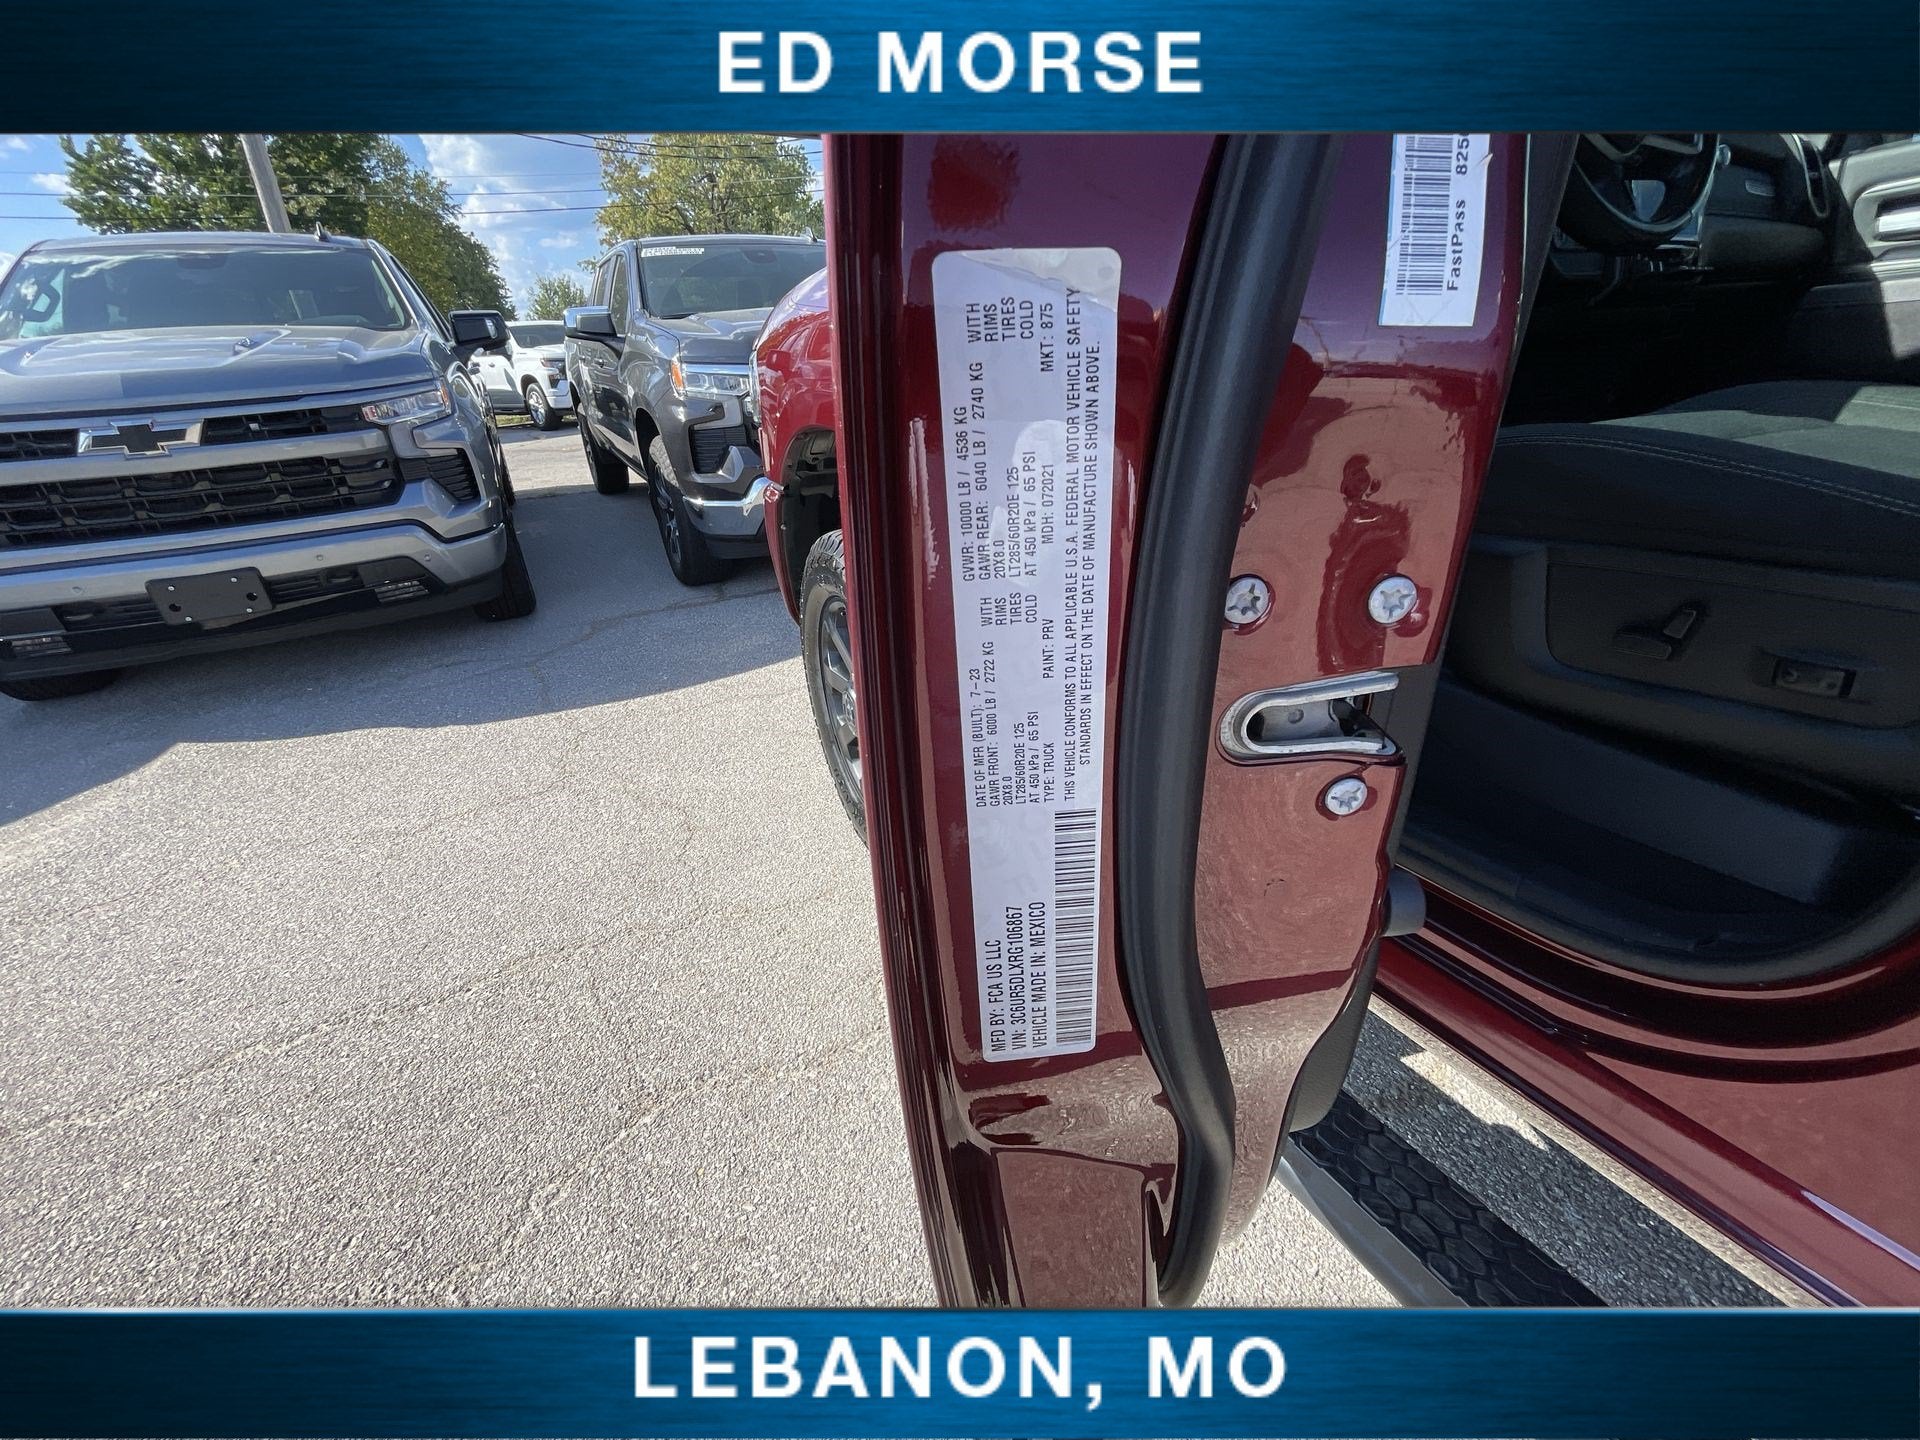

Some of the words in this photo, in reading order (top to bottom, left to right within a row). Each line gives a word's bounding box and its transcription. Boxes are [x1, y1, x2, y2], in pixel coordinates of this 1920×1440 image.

[1447, 200, 1465, 290] FastPass
[966, 303, 981, 343] WITH
[983, 304, 998, 341] RIMS
[1001, 297, 1015, 341] TIRES
[1020, 301, 1034, 339] COLD
[1040, 303, 1053, 329] 875
[1066, 288, 1080, 345] SAFETY
[1040, 336, 1054, 372] MKT:
[1086, 341, 1099, 393] ABOVE.
[970, 363, 983, 380] KG
[1067, 351, 1080, 411] VEHICLE
[954, 407, 967, 424] KG
[971, 388, 984, 419] 2740
[1085, 399, 1099, 450] SHOWN
[955, 431, 969, 461] 4536
[973, 441, 986, 456] LB
[1066, 416, 1080, 463] MOTOR
[1022, 451, 1035, 471] PSI
[958, 481, 970, 496] LB
[974, 462, 987, 491] 6040
[1007, 467, 1019, 488] 125
[1023, 478, 1035, 492] 65
[1041, 464, 1053, 507] 072021
[1066, 468, 1079, 525] FEDERAL
[1083, 456, 1097, 550] MANUFACTURE
[959, 502, 973, 536] 10000
[975, 501, 989, 539] REAR:
[1024, 511, 1036, 532] kPa
[1042, 513, 1054, 544] MDH:
[1007, 494, 1021, 577] LT285/60R20E
[1024, 537, 1036, 556] 450
[1066, 531, 1078, 567] U.S.A.
[962, 541, 974, 581] GVWR:
[977, 544, 991, 580] GAWR
[993, 540, 1005, 578] 20X8.0
[1025, 562, 1037, 576] AT
[1082, 556, 1095, 570] OF
[1082, 575, 1094, 604] DATE
[981, 598, 992, 626] WITH
[995, 598, 1007, 625] RIMS
[1010, 593, 1021, 624] TIRES
[1026, 595, 1037, 623] COLD
[1065, 573, 1078, 639] APPLICABLE
[1081, 609, 1094, 629] THE
[1043, 619, 1054, 639] PRV
[1081, 634, 1093, 648] ON
[982, 642, 994, 655] KG
[1043, 644, 1054, 678] PAINT:
[1065, 643, 1076, 662] ALL
[984, 659, 995, 683] 2722
[1065, 667, 1076, 679] TO
[1081, 653, 1092, 690] EFFECT
[986, 698, 996, 709] LB
[1065, 683, 1076, 736] CONFORMS
[1081, 694, 1091, 704] IN
[971, 704, 985, 742] (BUILT):
[986, 713, 997, 735] 6000
[1014, 723, 1024, 738] 125
[1028, 712, 1038, 726] PSI
[1028, 730, 1038, 741] 65
[1079, 708, 1091, 765] STANDARDS
[973, 746, 984, 766] MFR
[987, 743, 999, 775] FRONT:
[1028, 755, 1039, 770] kPa
[1043, 743, 1054, 773] TRUCK
[1065, 740, 1076, 777] VEHICLE
[974, 770, 985, 781] OF
[1015, 743, 1026, 804] LT285/60R20E
[1029, 774, 1039, 788] 450
[975, 785, 986, 807] DATE
[989, 780, 1000, 806] GAWR
[1002, 776, 1013, 805] 20X8.0
[1029, 793, 1039, 803] AT
[1044, 777, 1055, 802] TYPE:
[1064, 781, 1075, 801] THIS
[1029, 902, 1045, 947] MEXICO
[985, 940, 1001, 959] LLC
[1030, 952, 1045, 967] IN:
[986, 964, 1002, 978] US
[1006, 906, 1026, 1025] 3C6UR5DLXRG106867
[987, 983, 1003, 1003] FCA
[1031, 971, 1046, 1002] MADE
[989, 1009, 1004, 1025] BY:
[1031, 1007, 1047, 1048] VEHICLE
[991, 1030, 1005, 1051] MFD
[1012, 1030, 1027, 1050] VIN:
